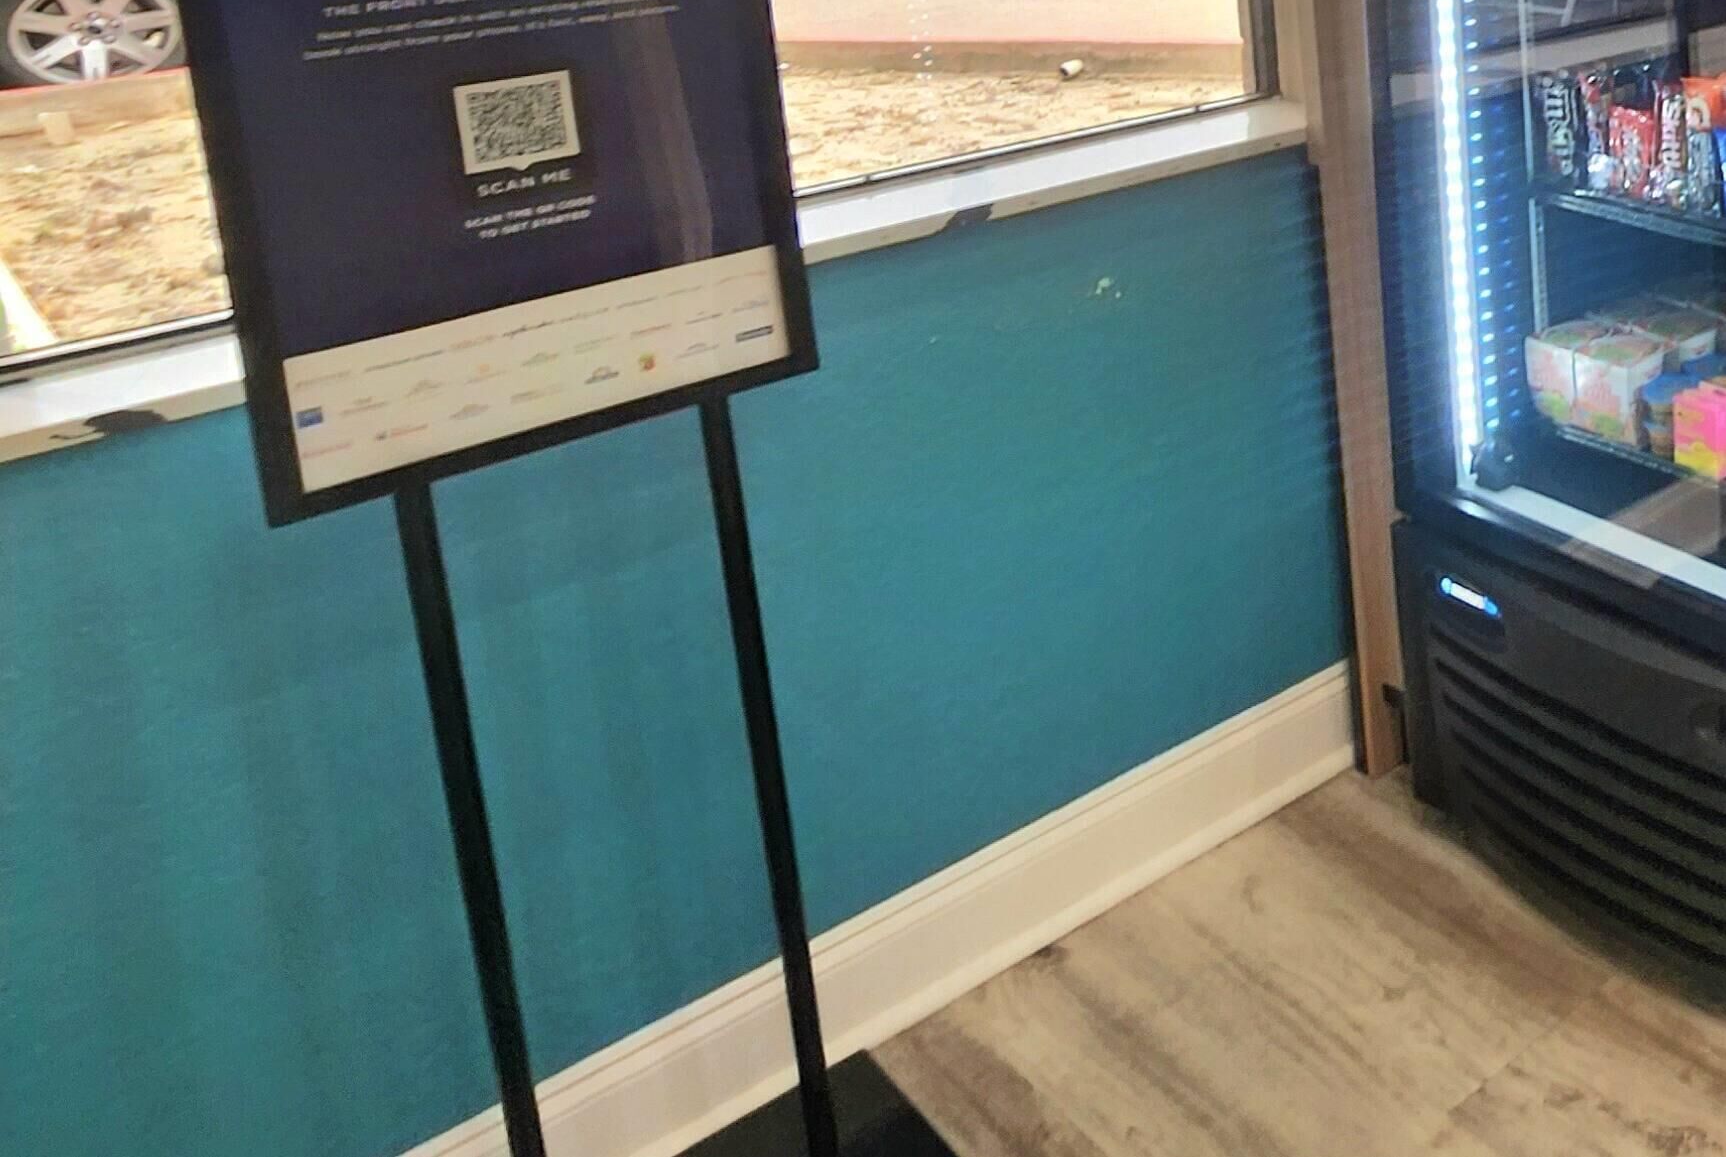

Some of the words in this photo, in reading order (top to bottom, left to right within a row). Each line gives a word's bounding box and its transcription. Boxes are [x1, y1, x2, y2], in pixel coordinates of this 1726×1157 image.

[322, 3, 360, 18] THE
[476, 175, 535, 197] SCAN
[541, 167, 572, 184] ME
